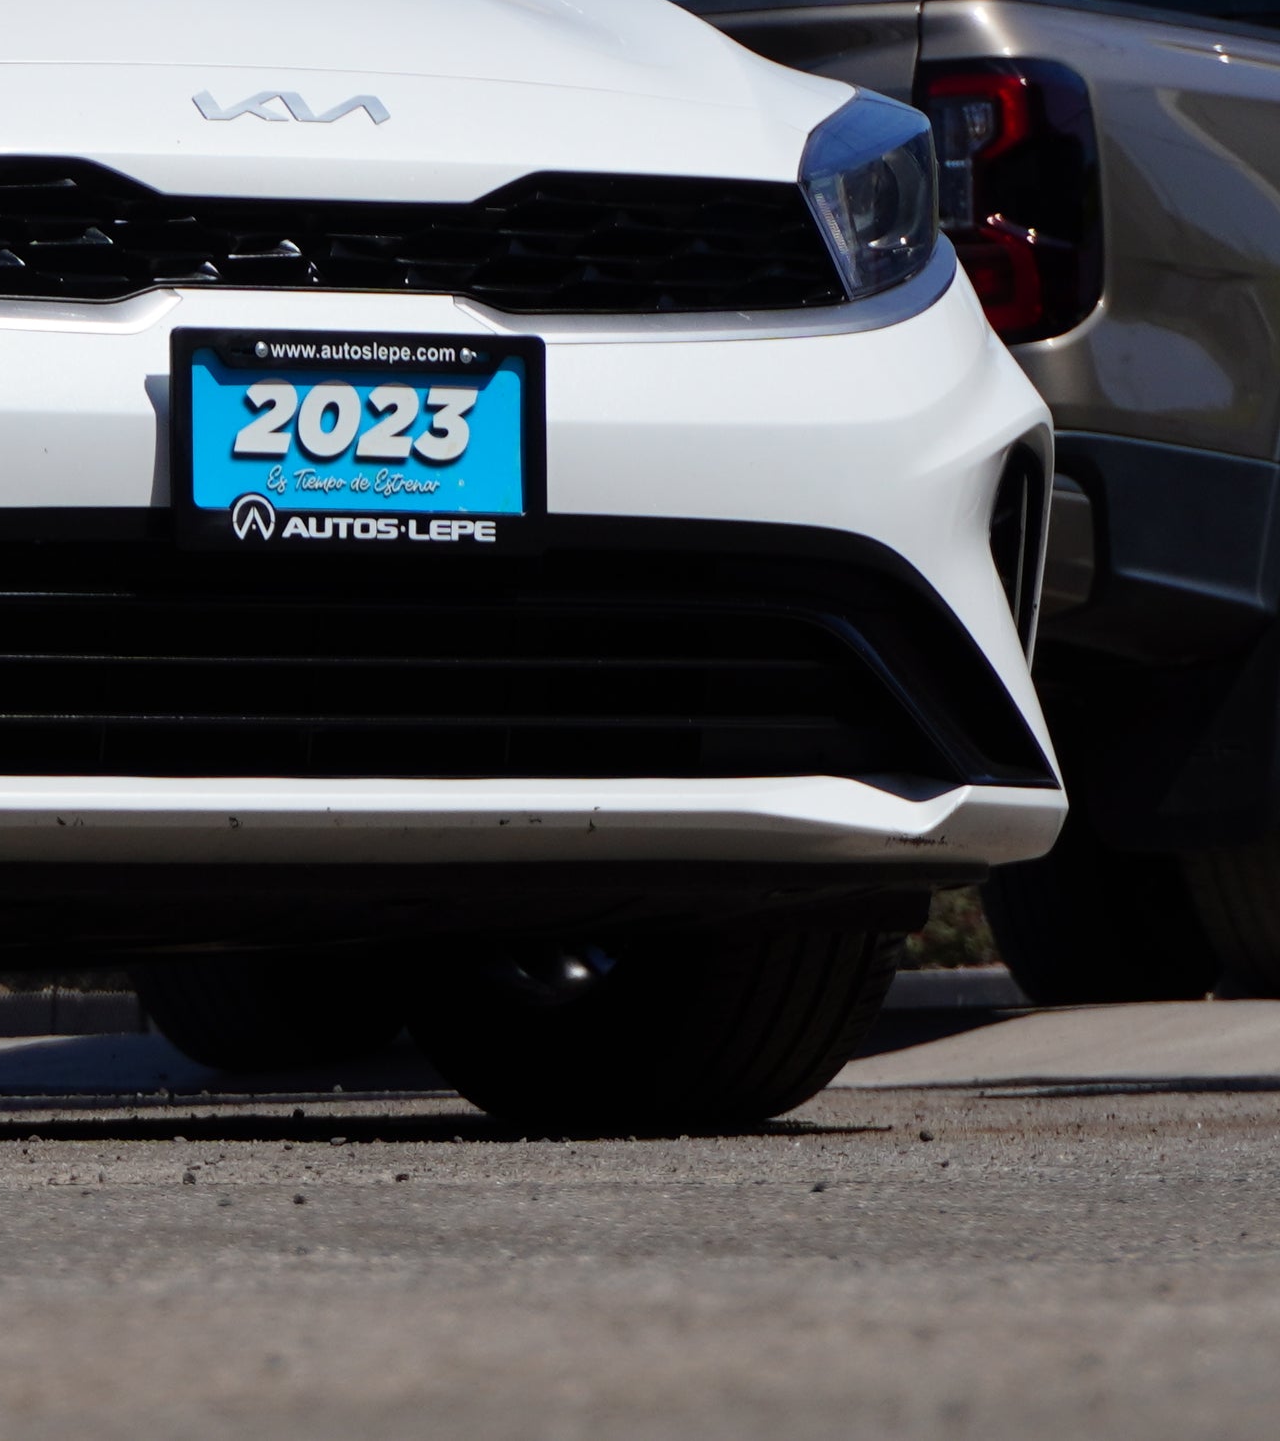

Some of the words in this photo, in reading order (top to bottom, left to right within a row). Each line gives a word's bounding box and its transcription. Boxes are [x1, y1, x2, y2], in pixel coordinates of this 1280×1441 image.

[269, 341, 456, 364] www.autoslepe.com
[233, 378, 480, 463] 2023
[266, 464, 288, 494] Es
[293, 468, 347, 495] Tiempo
[350, 472, 371, 492] de
[373, 467, 441, 496] Estrenar
